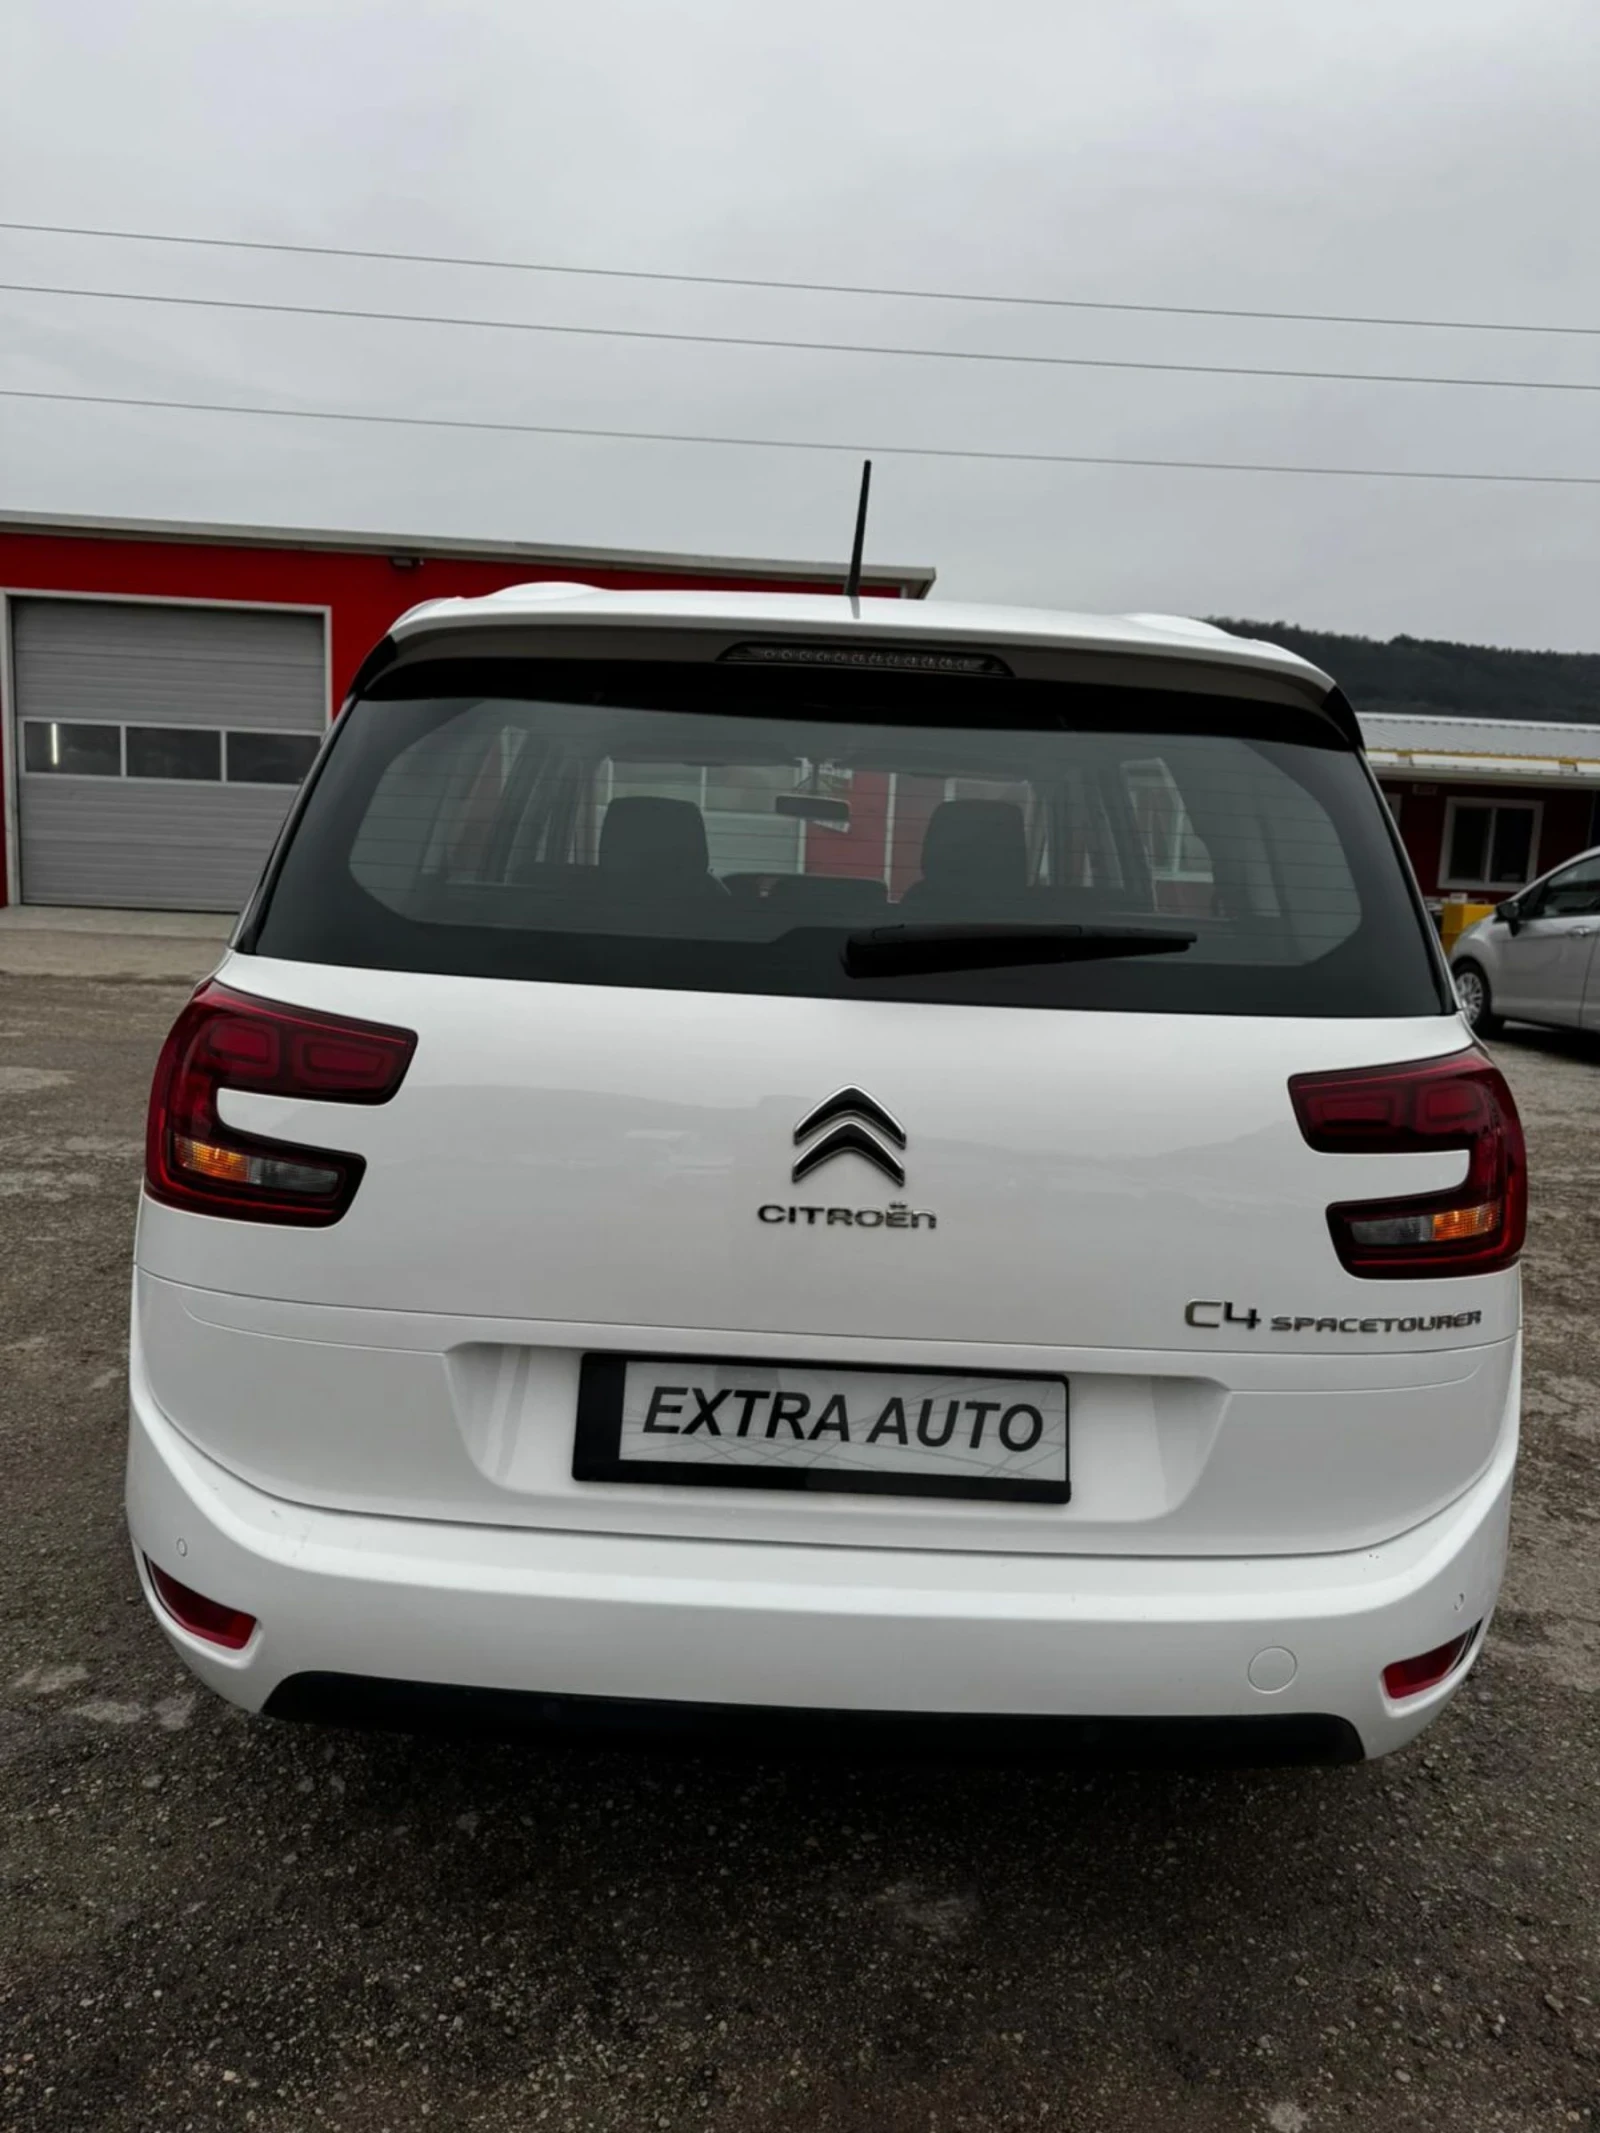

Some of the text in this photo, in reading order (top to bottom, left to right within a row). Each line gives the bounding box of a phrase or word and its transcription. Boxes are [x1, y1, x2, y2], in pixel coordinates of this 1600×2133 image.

[1184, 1300, 1482, 1333] C4 SPACETOURER
[643, 1386, 1045, 1453] EXTRA AUTO
